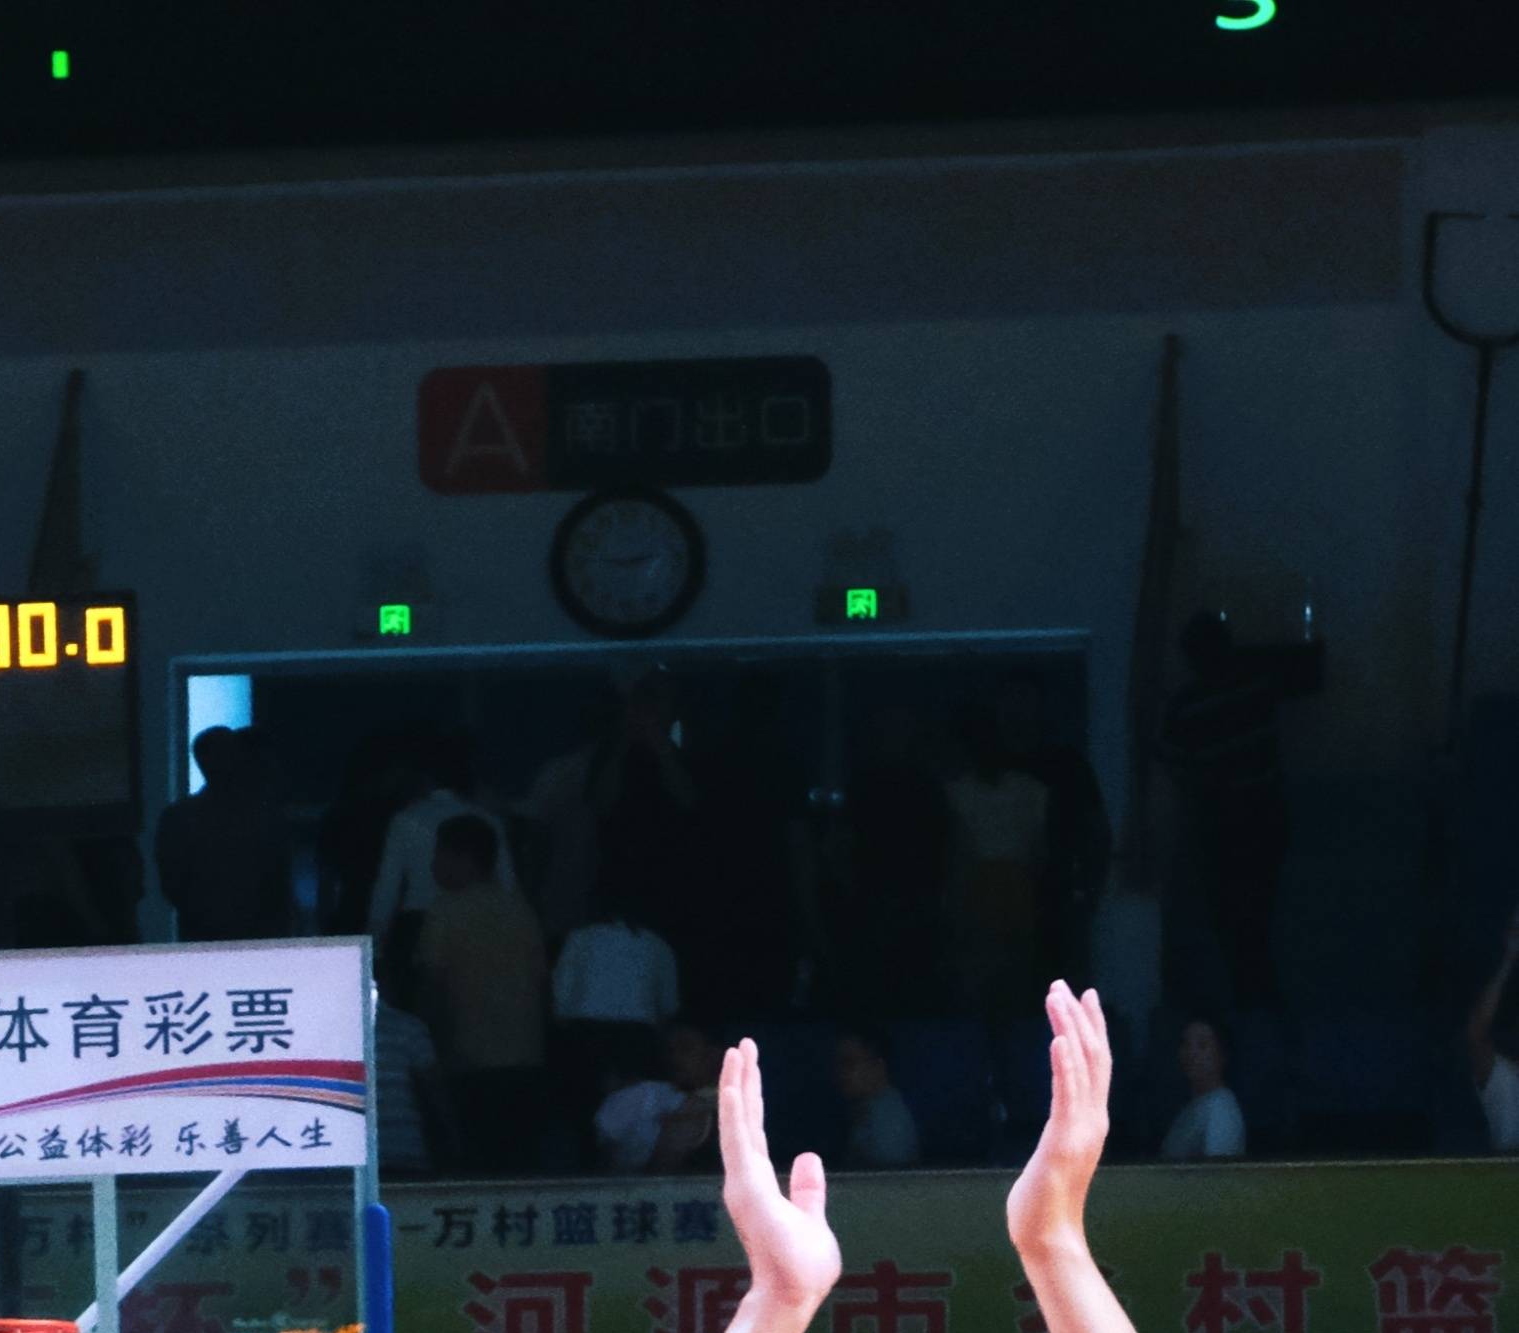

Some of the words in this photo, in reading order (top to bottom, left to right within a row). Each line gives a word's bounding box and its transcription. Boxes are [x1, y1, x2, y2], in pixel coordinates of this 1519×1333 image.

[443, 378, 531, 480] A
[564, 390, 812, 454] 南门出口
[174, 1117, 332, 1156] 乐善人生
